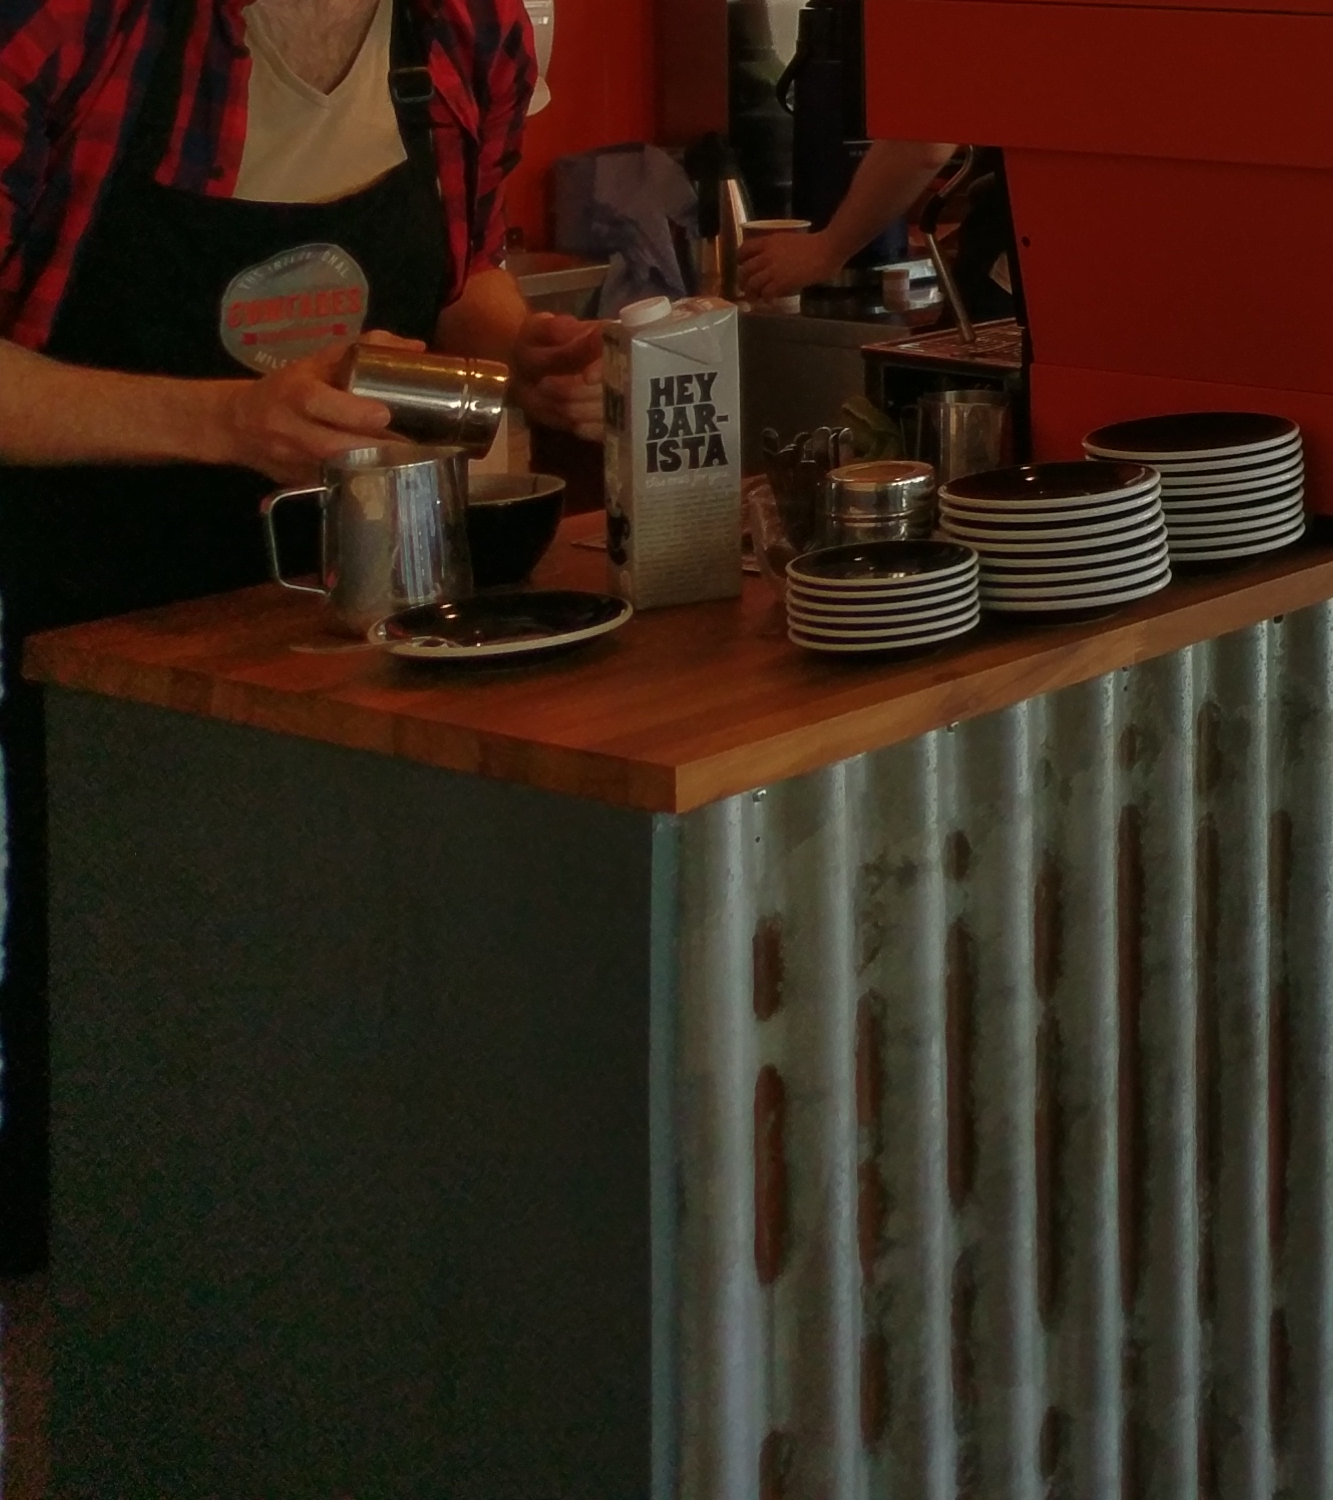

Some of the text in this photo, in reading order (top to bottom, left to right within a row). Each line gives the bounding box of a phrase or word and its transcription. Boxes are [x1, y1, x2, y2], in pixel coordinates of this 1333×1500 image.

[650, 372, 718, 408] HEY
[647, 403, 729, 442] BAR-
[645, 433, 729, 474] ISTA
